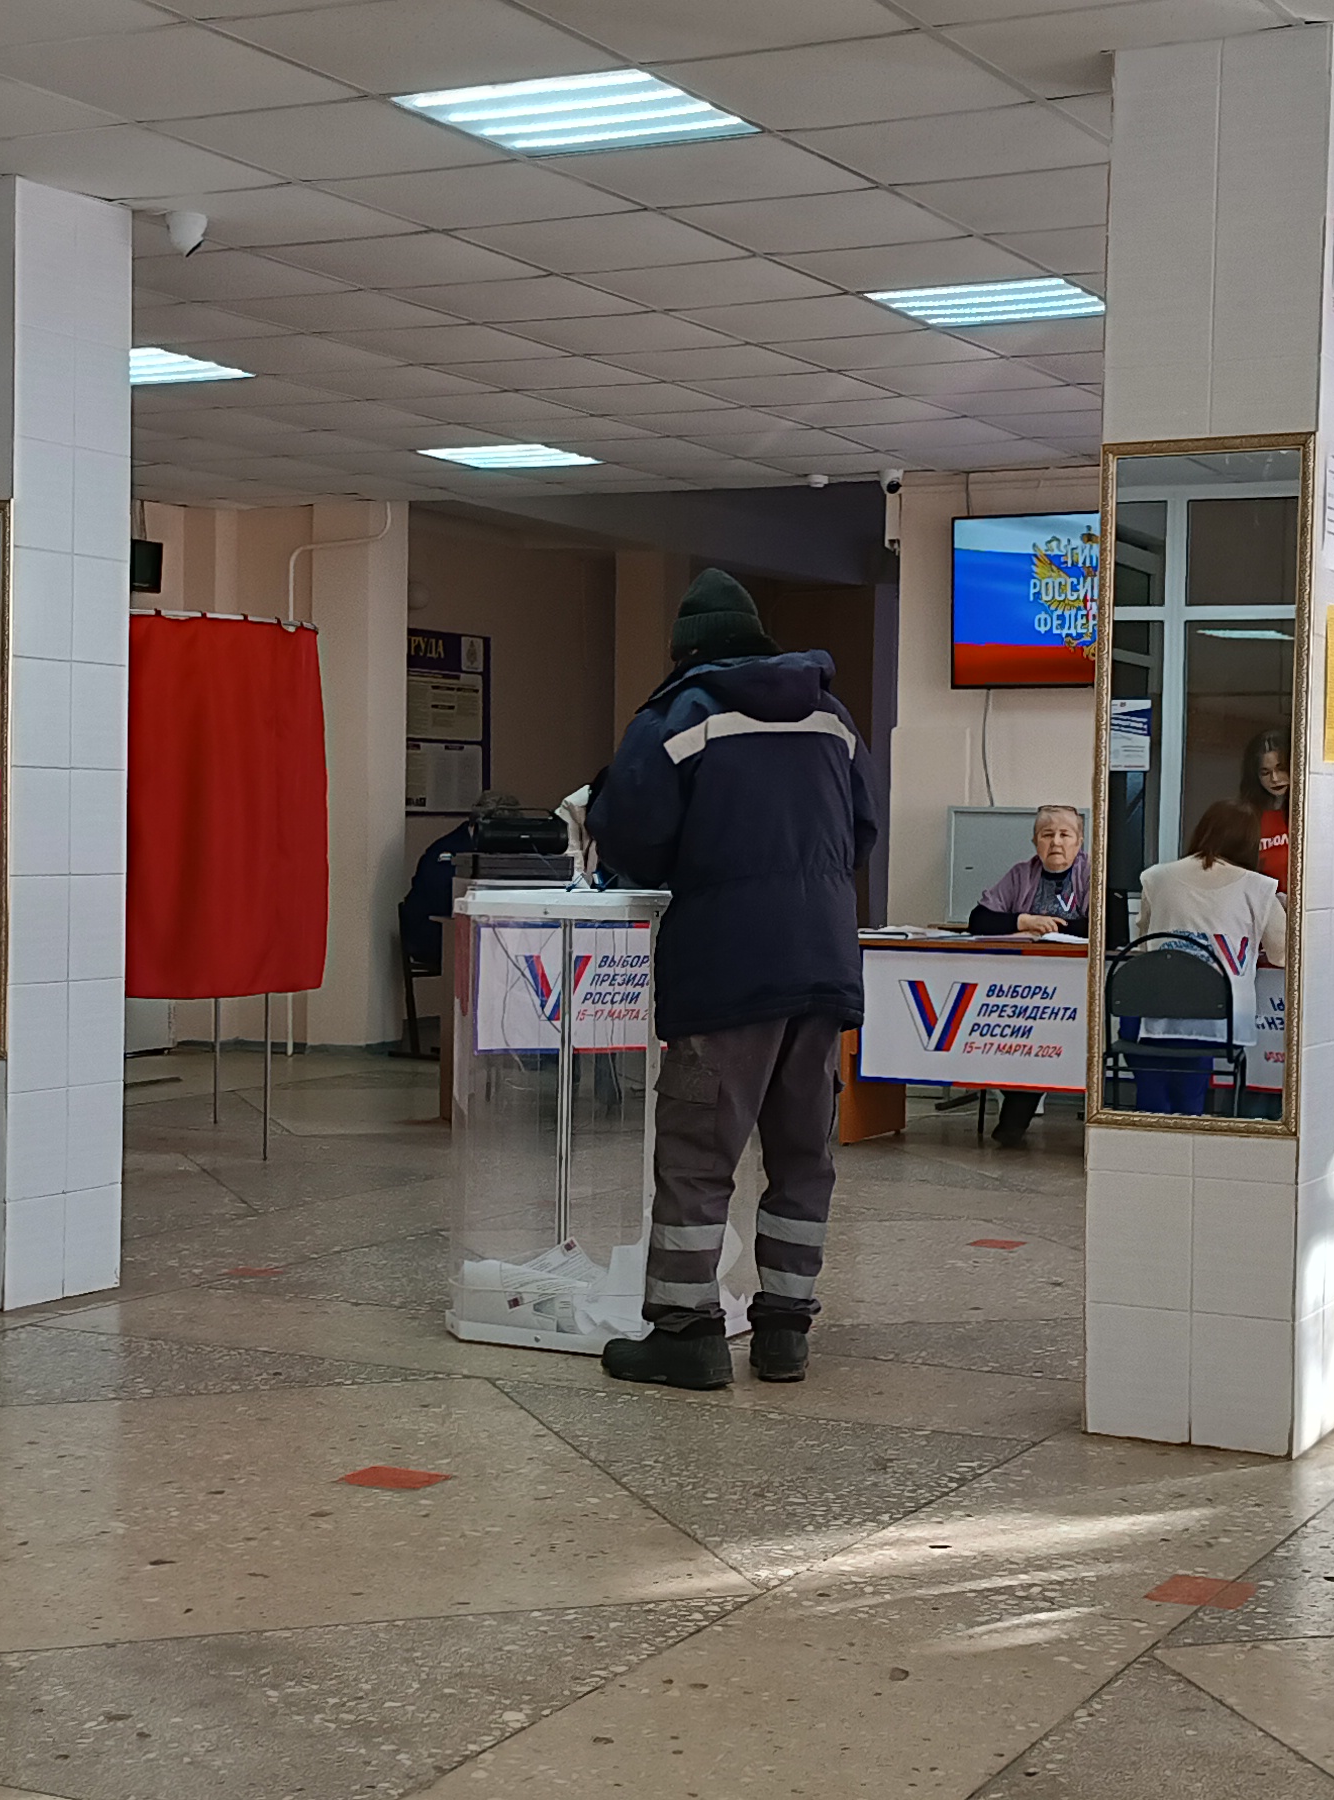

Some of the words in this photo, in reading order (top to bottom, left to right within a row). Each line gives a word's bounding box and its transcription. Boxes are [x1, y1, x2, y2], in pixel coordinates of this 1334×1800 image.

[598, 955, 650, 969] ВЫБОР
[590, 973, 650, 988] ПРЕЗИД
[581, 991, 642, 1005] РОССИИ
[985, 983, 1057, 1001] ВЫБОРЫ
[606, 1008, 641, 1021] МАРТА
[976, 1002, 1078, 1022] ПРЕЗИДЕНТА
[968, 1022, 1033, 1039] РОССИИ
[994, 1042, 1034, 1057] МАРТА
[1034, 1045, 1063, 1058] 2024
